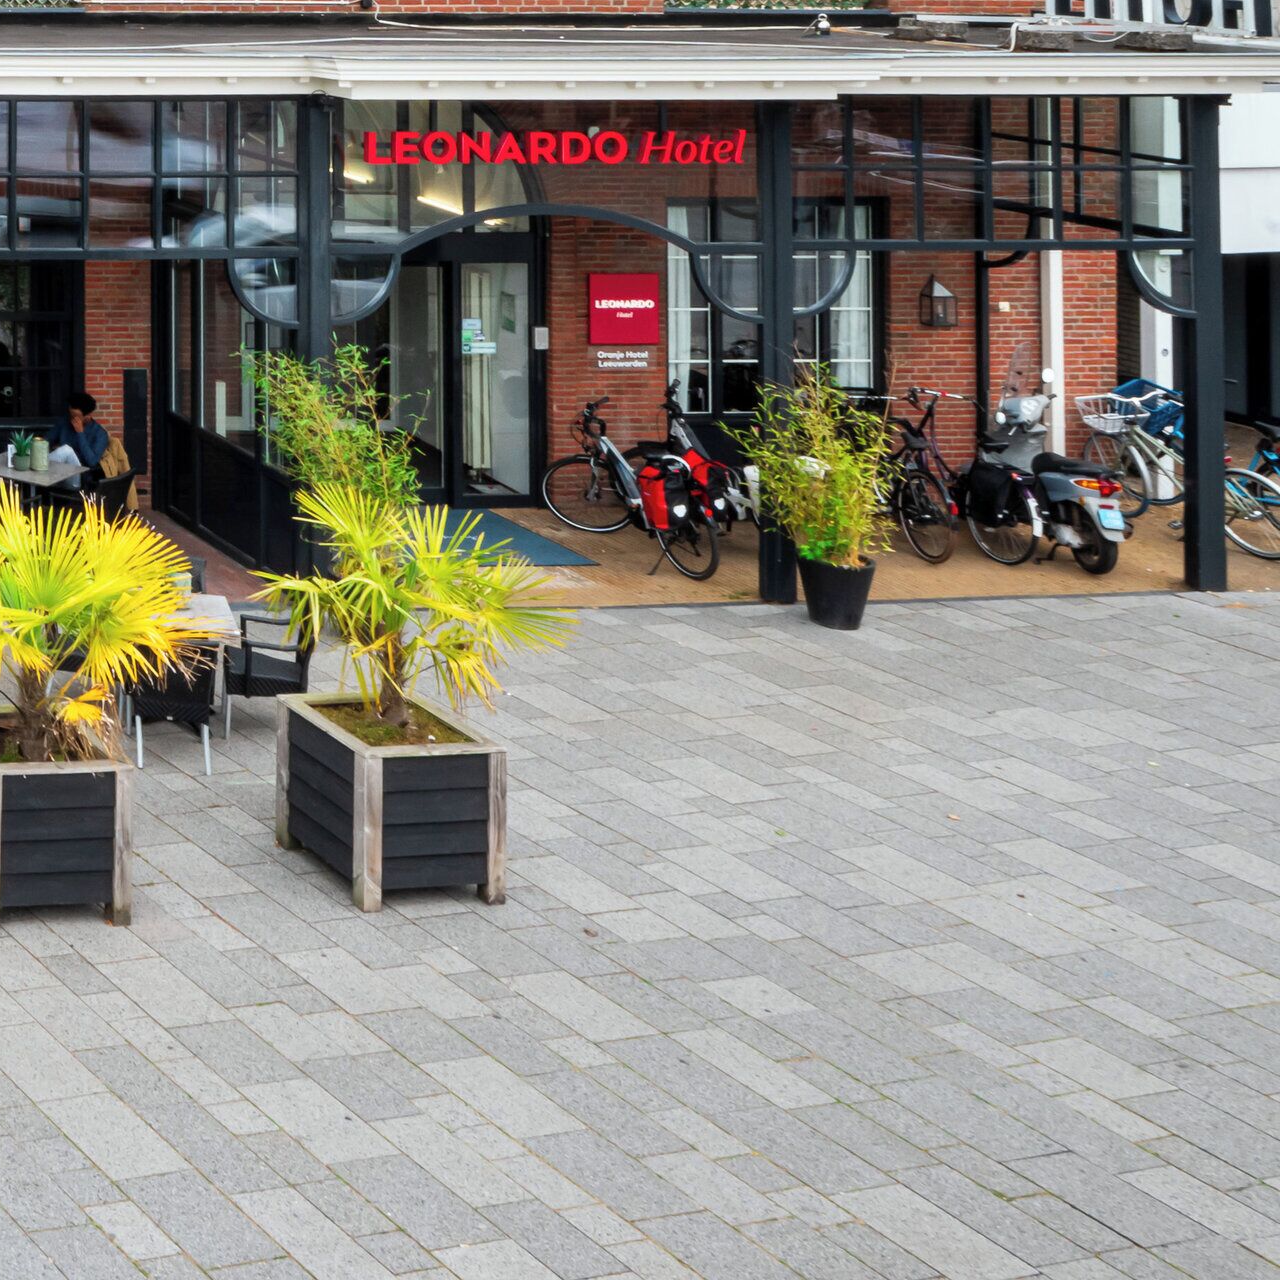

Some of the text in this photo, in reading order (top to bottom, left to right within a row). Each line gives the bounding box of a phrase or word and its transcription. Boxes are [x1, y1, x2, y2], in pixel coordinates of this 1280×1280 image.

[363, 129, 747, 165] LEONARDO Hotel
[594, 299, 655, 309] LEONARDO
[597, 351, 648, 359] Oranje Hotel
[598, 360, 648, 368] Leeuwarden
